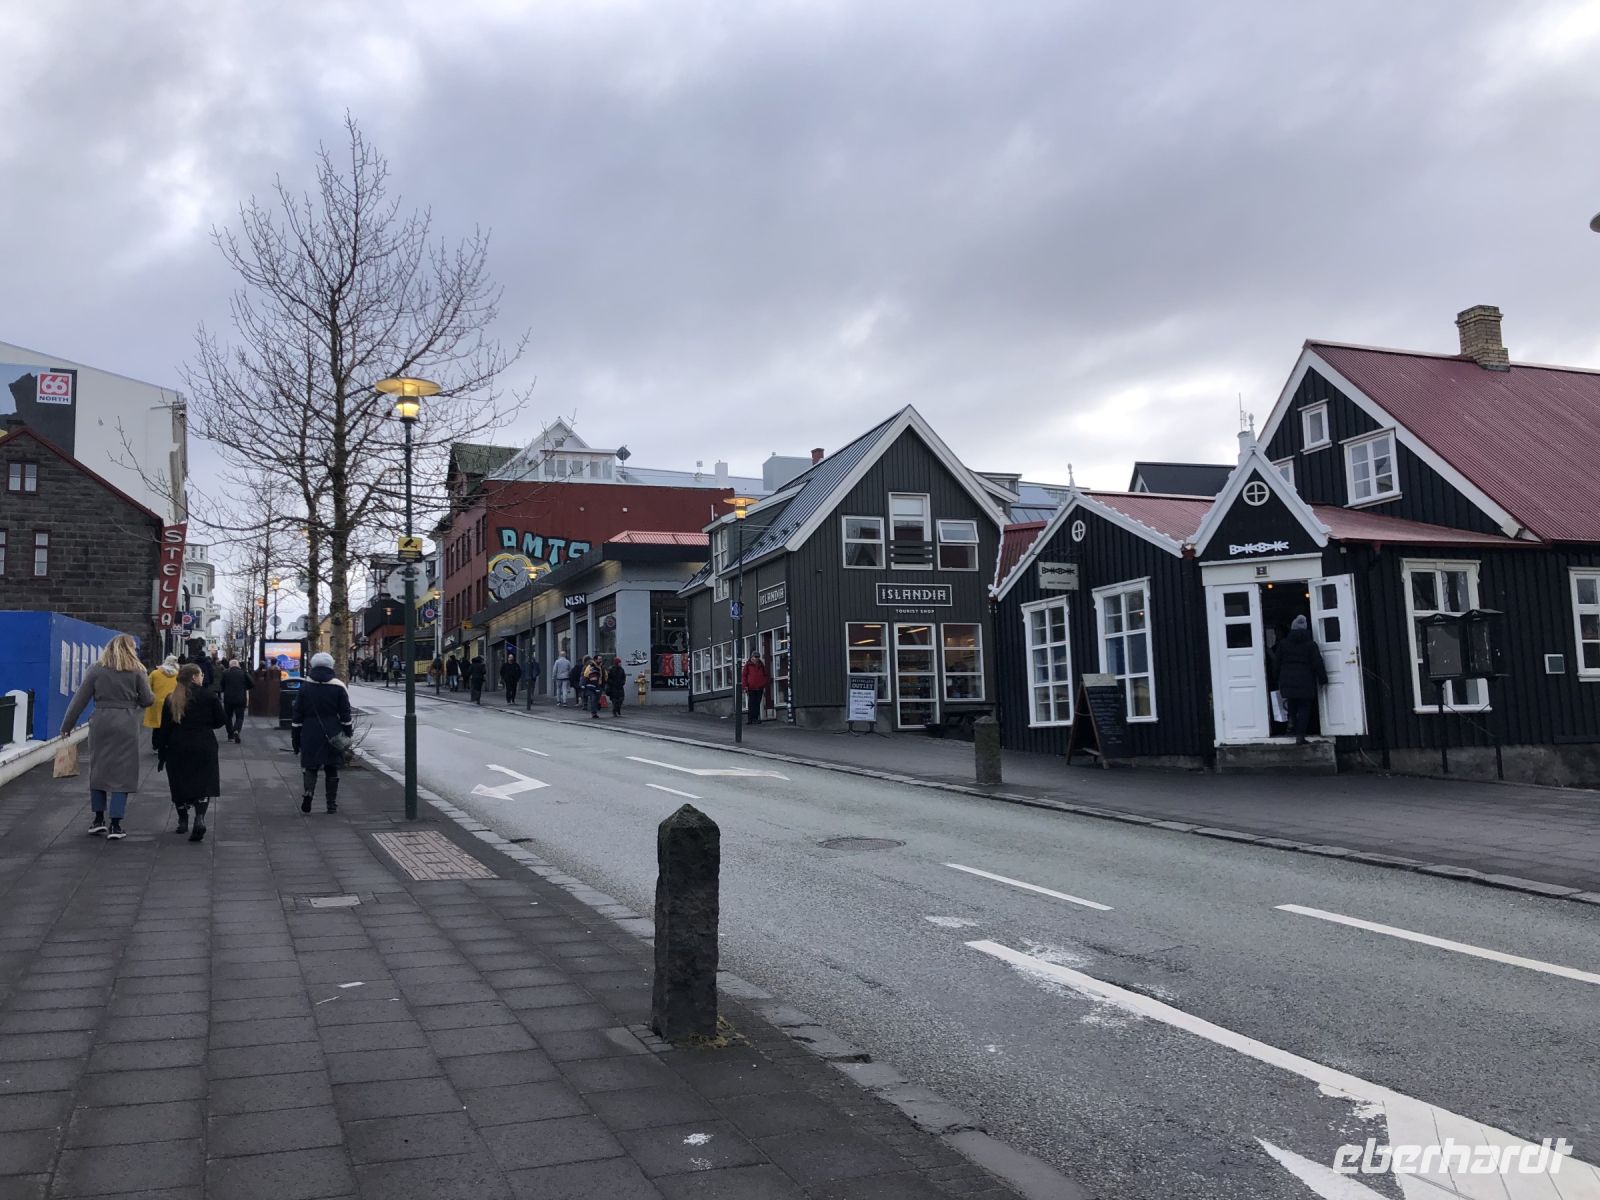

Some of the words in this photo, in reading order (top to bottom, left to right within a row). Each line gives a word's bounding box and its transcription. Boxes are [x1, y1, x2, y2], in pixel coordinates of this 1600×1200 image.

[161, 530, 183, 626] STELLA
[565, 594, 585, 607] NLSN
[759, 587, 785, 606] ISLANDIA
[881, 588, 946, 600] ISLANDIA
